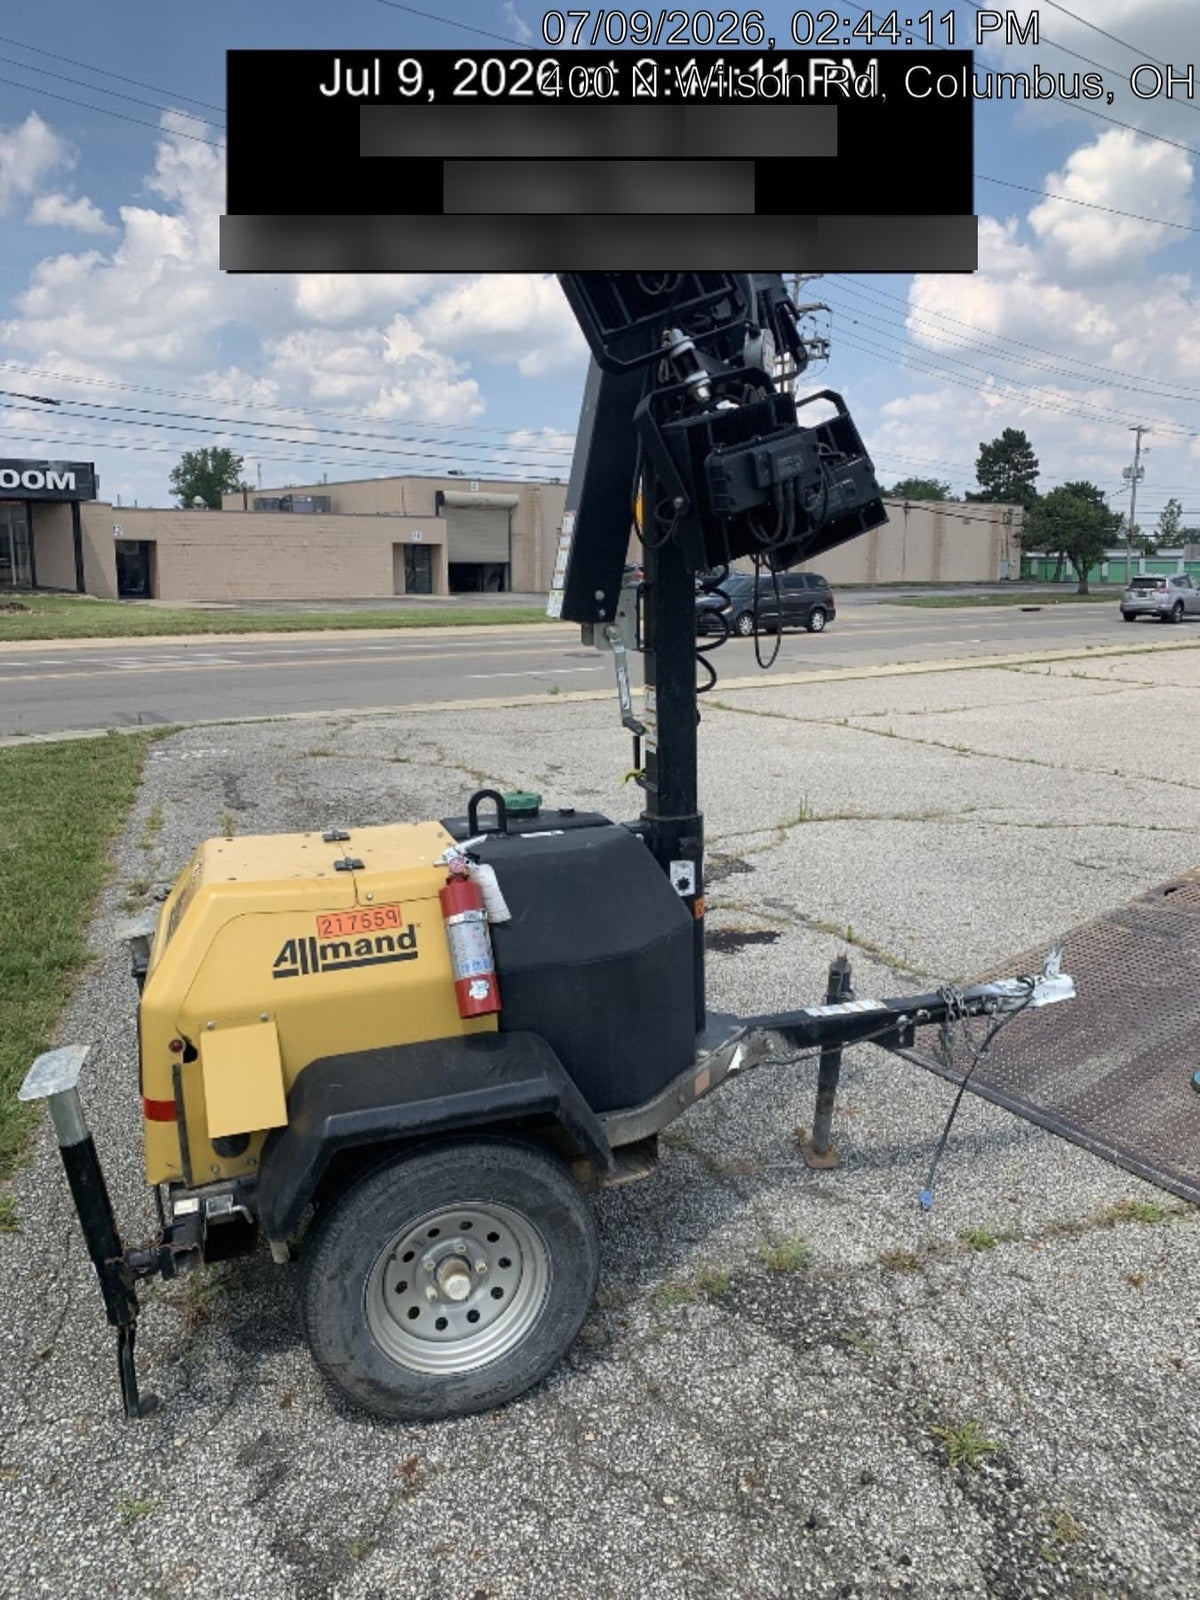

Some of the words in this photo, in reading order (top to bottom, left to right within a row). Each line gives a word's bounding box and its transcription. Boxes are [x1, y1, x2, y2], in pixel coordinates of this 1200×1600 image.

[0, 469, 76, 491] OOM
[320, 909, 399, 936] 217559
[272, 923, 418, 976] Allmand
